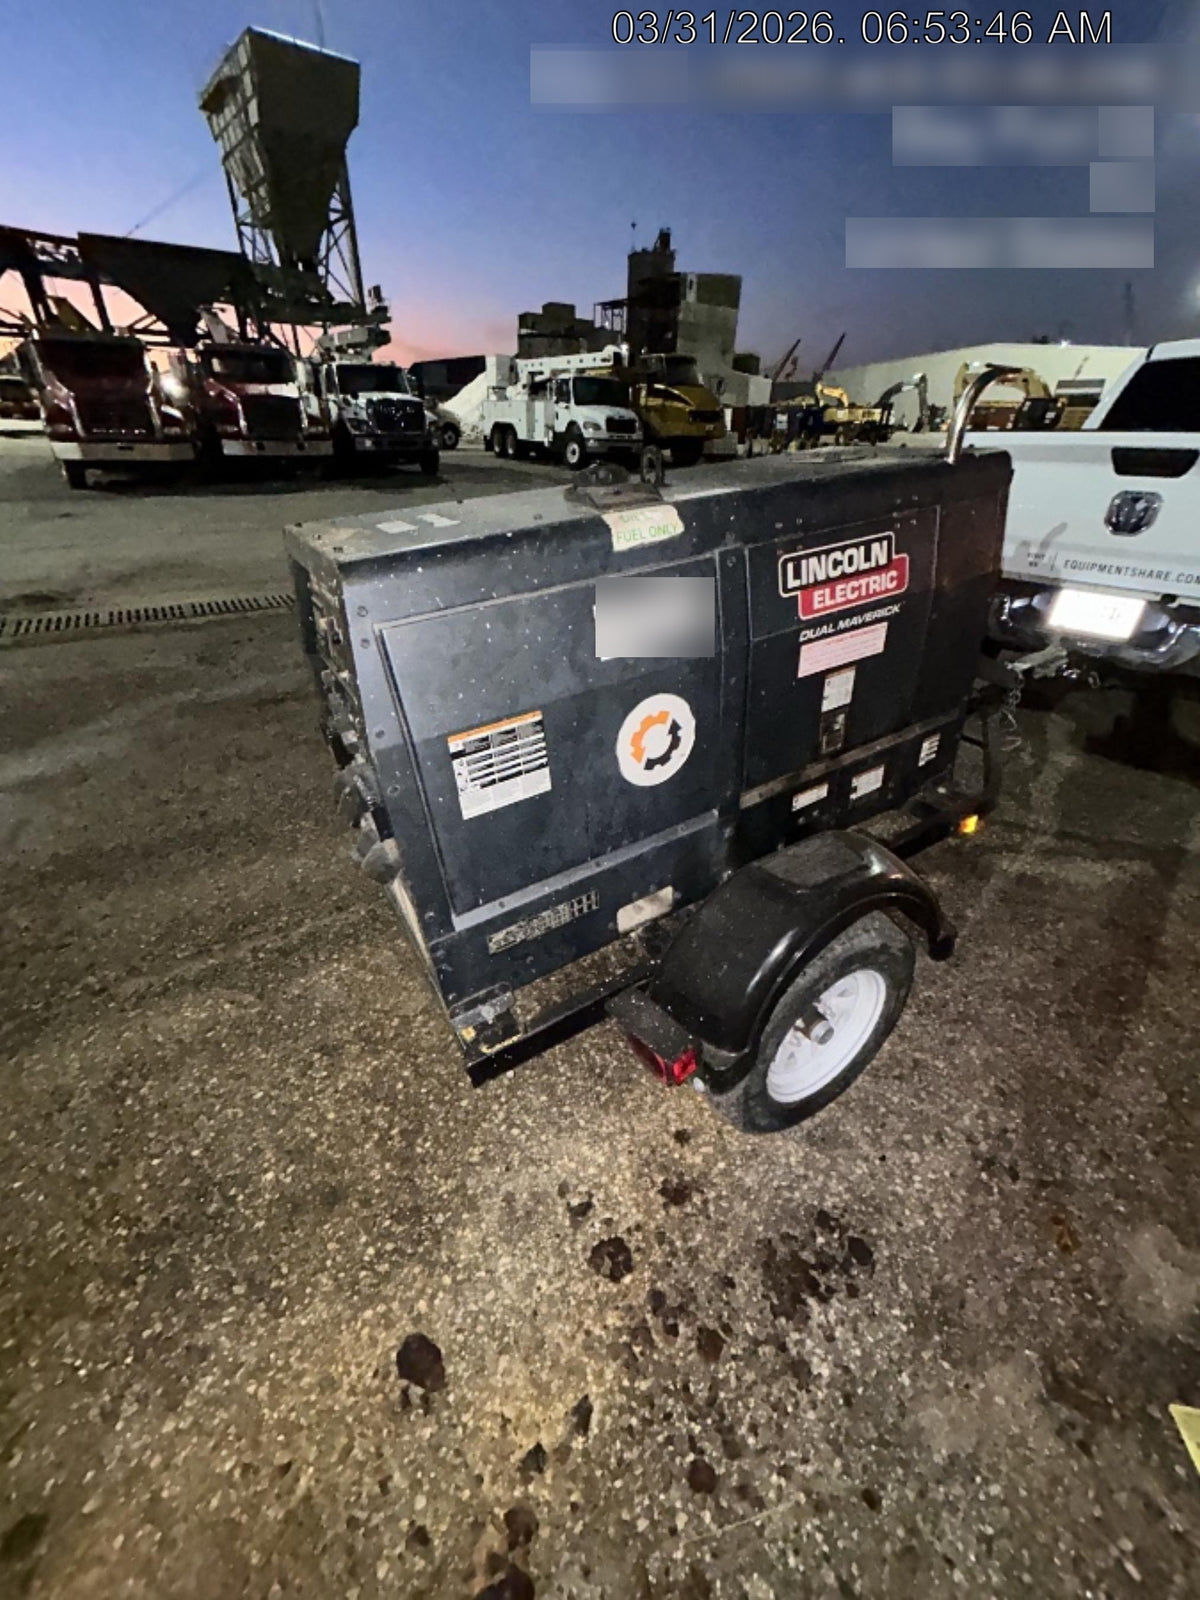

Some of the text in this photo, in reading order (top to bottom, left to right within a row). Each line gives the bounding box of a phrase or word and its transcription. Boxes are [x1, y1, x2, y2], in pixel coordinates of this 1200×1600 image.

[616, 522, 678, 544] FUEL ONLY
[787, 540, 888, 589] LINCOLN
[813, 570, 898, 610] ELECTRIC
[799, 603, 900, 642] DUAL MAVERICK
